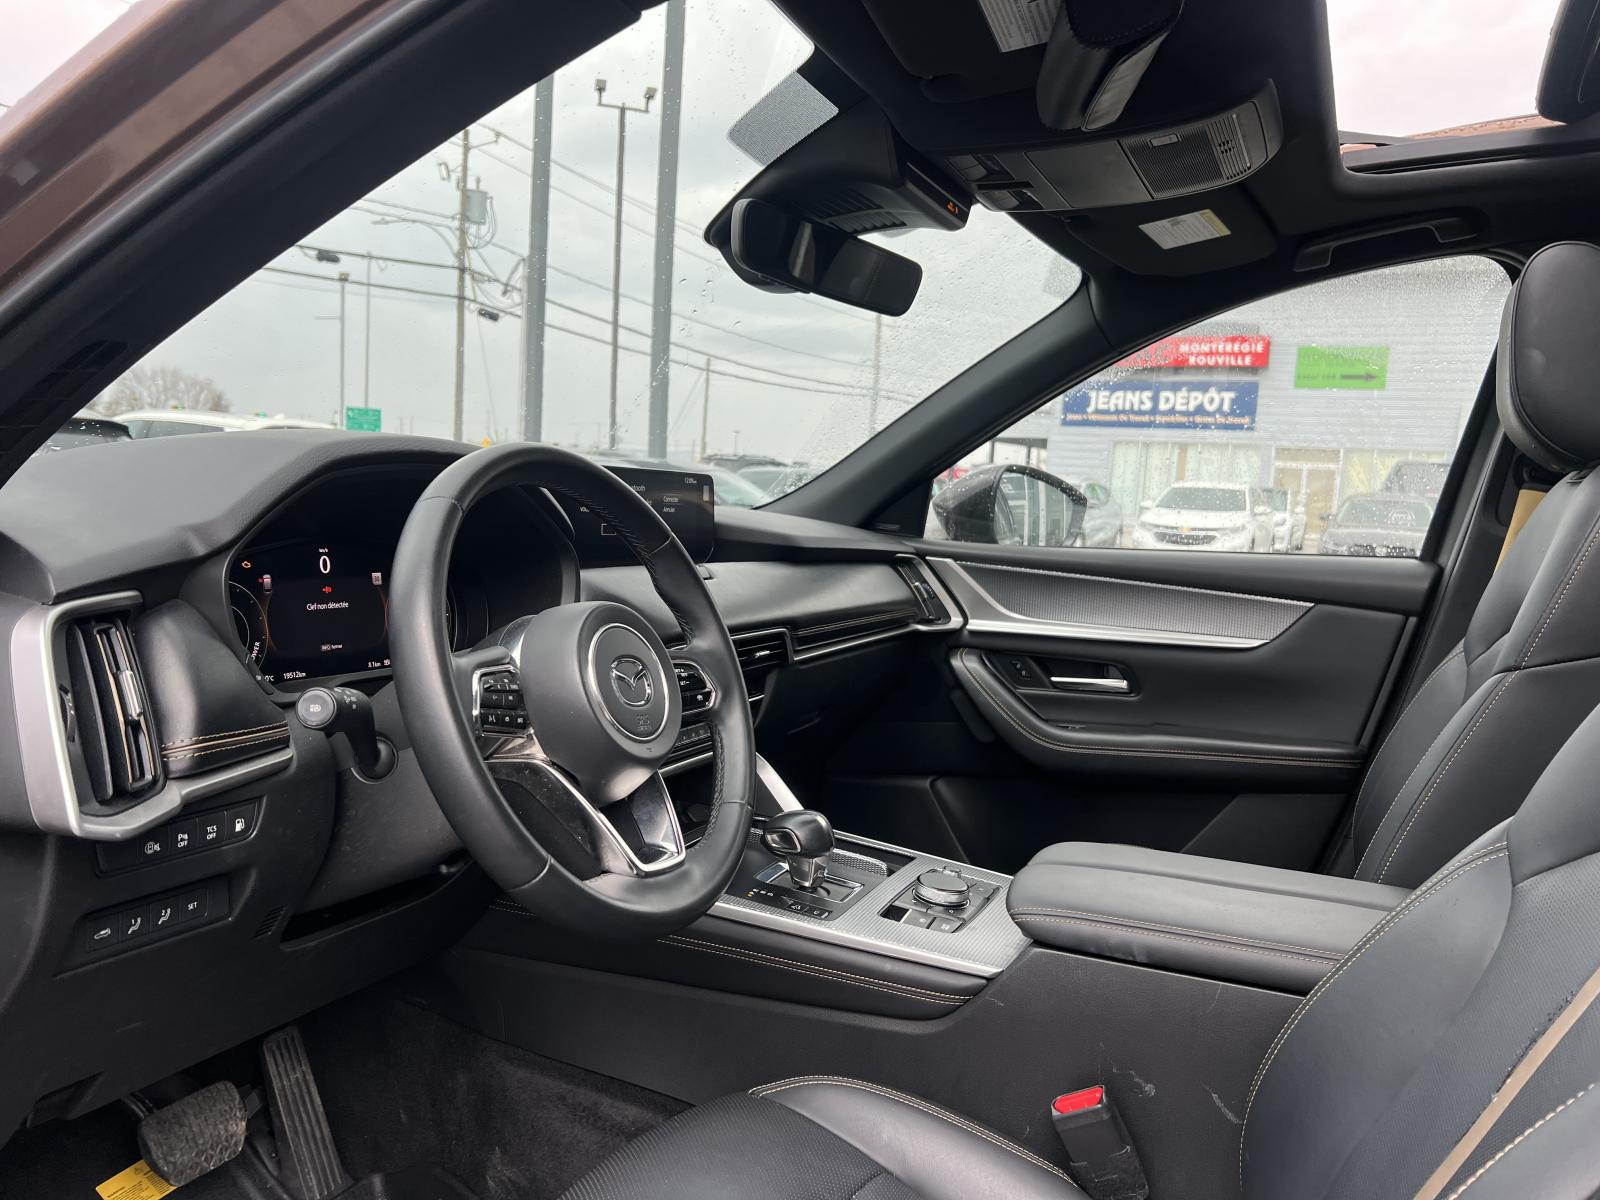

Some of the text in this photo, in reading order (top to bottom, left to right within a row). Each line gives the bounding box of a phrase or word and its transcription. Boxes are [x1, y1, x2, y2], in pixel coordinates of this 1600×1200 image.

[1188, 354, 1253, 366] ROUVILLE
[1086, 387, 1236, 413] JEANS DÉPÔT
[319, 555, 331, 574] 0
[306, 603, 317, 611] Clef
[327, 601, 349, 609] détectée
[188, 902, 198, 910] SET
